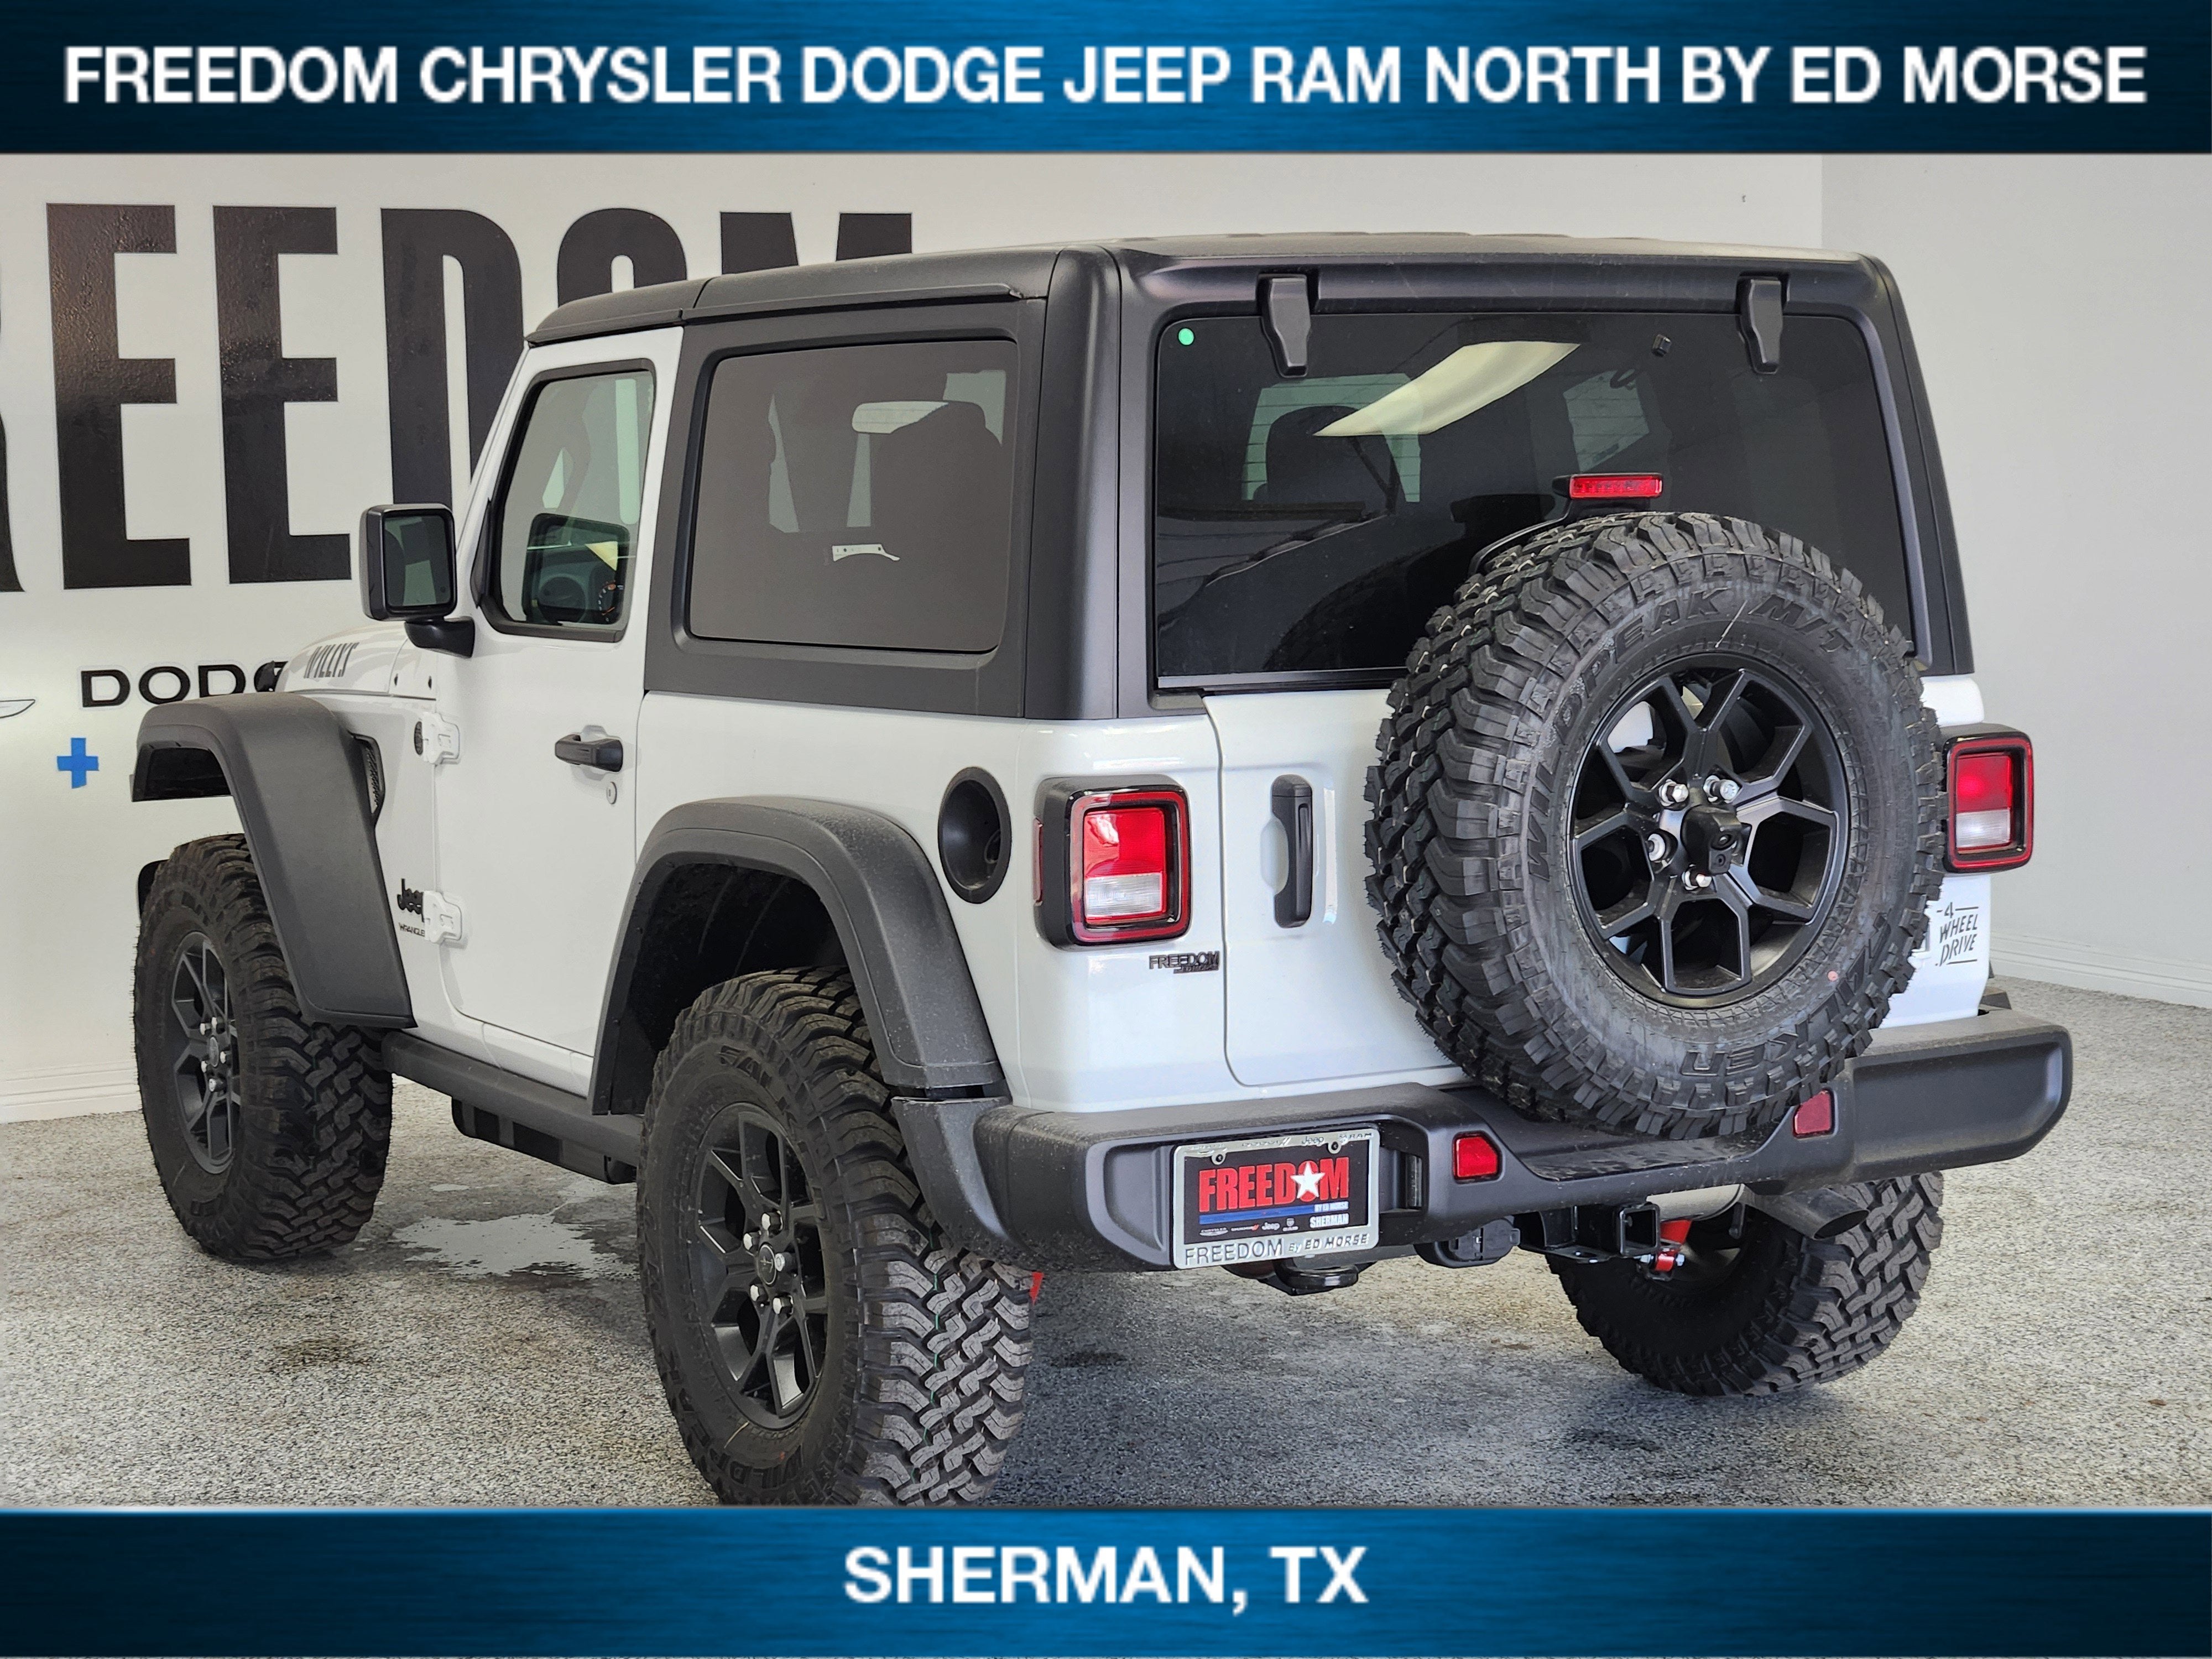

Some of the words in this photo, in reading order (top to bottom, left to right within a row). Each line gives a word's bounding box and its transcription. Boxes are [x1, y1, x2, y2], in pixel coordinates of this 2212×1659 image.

[304, 642, 359, 679] WILLYS
[1944, 902, 1953, 918] 4
[398, 922, 425, 937] WRANGLE
[1939, 914, 1978, 943] WHEEL
[1149, 951, 1220, 969] FREEDOM
[1939, 933, 1978, 967] DRIVE
[1199, 1157, 1349, 1213] FREEDOM
[1261, 1222, 1280, 1230] Jeep
[1310, 1213, 1349, 1228] SHERMAN
[1185, 1238, 1283, 1266] FREEDOM
[1305, 1238, 1321, 1250] ED
